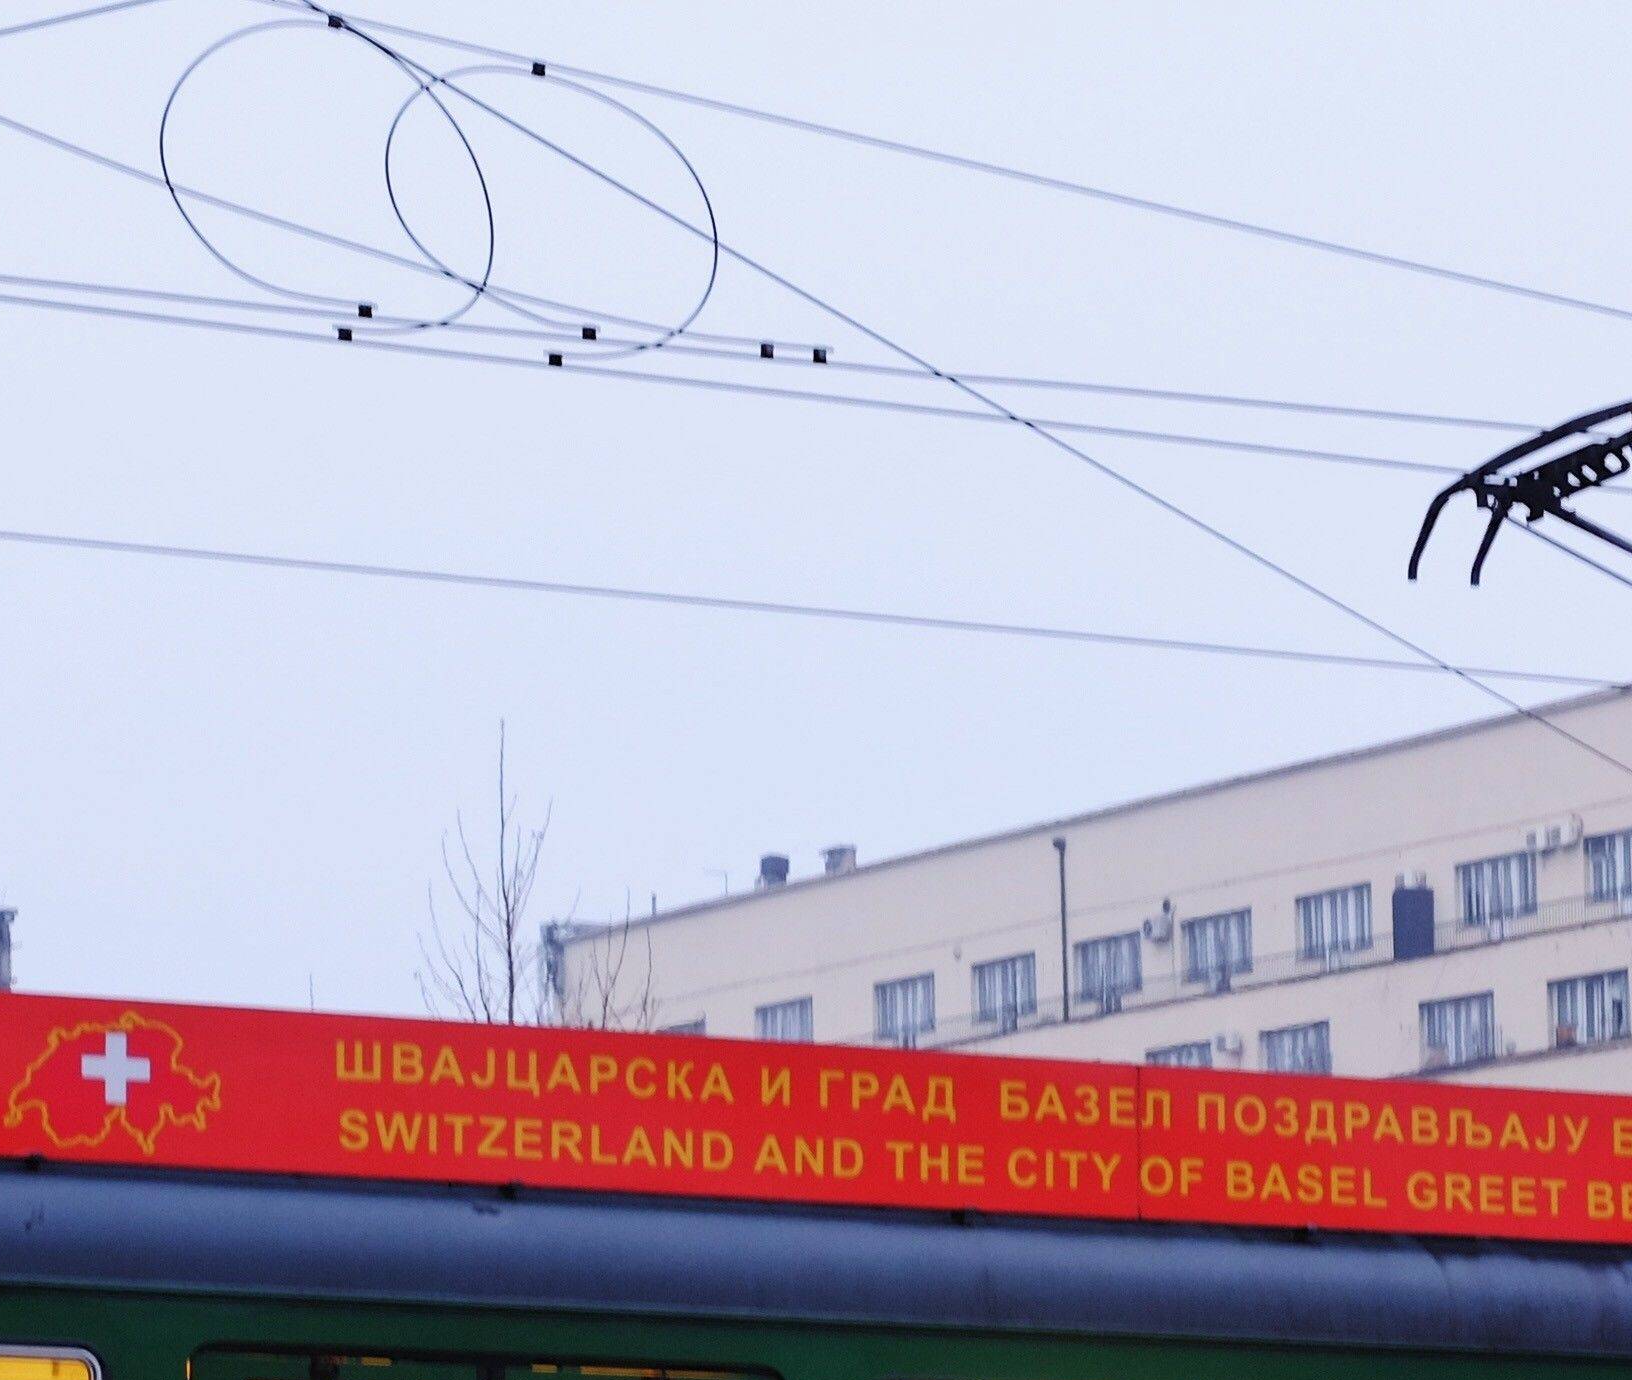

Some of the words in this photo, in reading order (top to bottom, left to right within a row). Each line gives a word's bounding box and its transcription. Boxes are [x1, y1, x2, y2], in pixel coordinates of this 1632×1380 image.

[334, 1039, 734, 1103] ШВАЈЦАРСКА
[761, 1067, 791, 1107] И
[818, 1070, 957, 1123] ГРАД
[999, 1081, 1172, 1130] БАЗЕЛ
[1196, 1093, 1589, 1156] ПОЗДРАВЉАЈУ
[338, 1109, 735, 1174] SWITZERLAND
[753, 1134, 865, 1178] AND
[886, 1142, 985, 1185] THE
[1006, 1148, 1121, 1192] CITY
[1139, 1156, 1204, 1196] OF
[1225, 1160, 1388, 1208] BASEL
[1405, 1171, 1567, 1217] GREET
